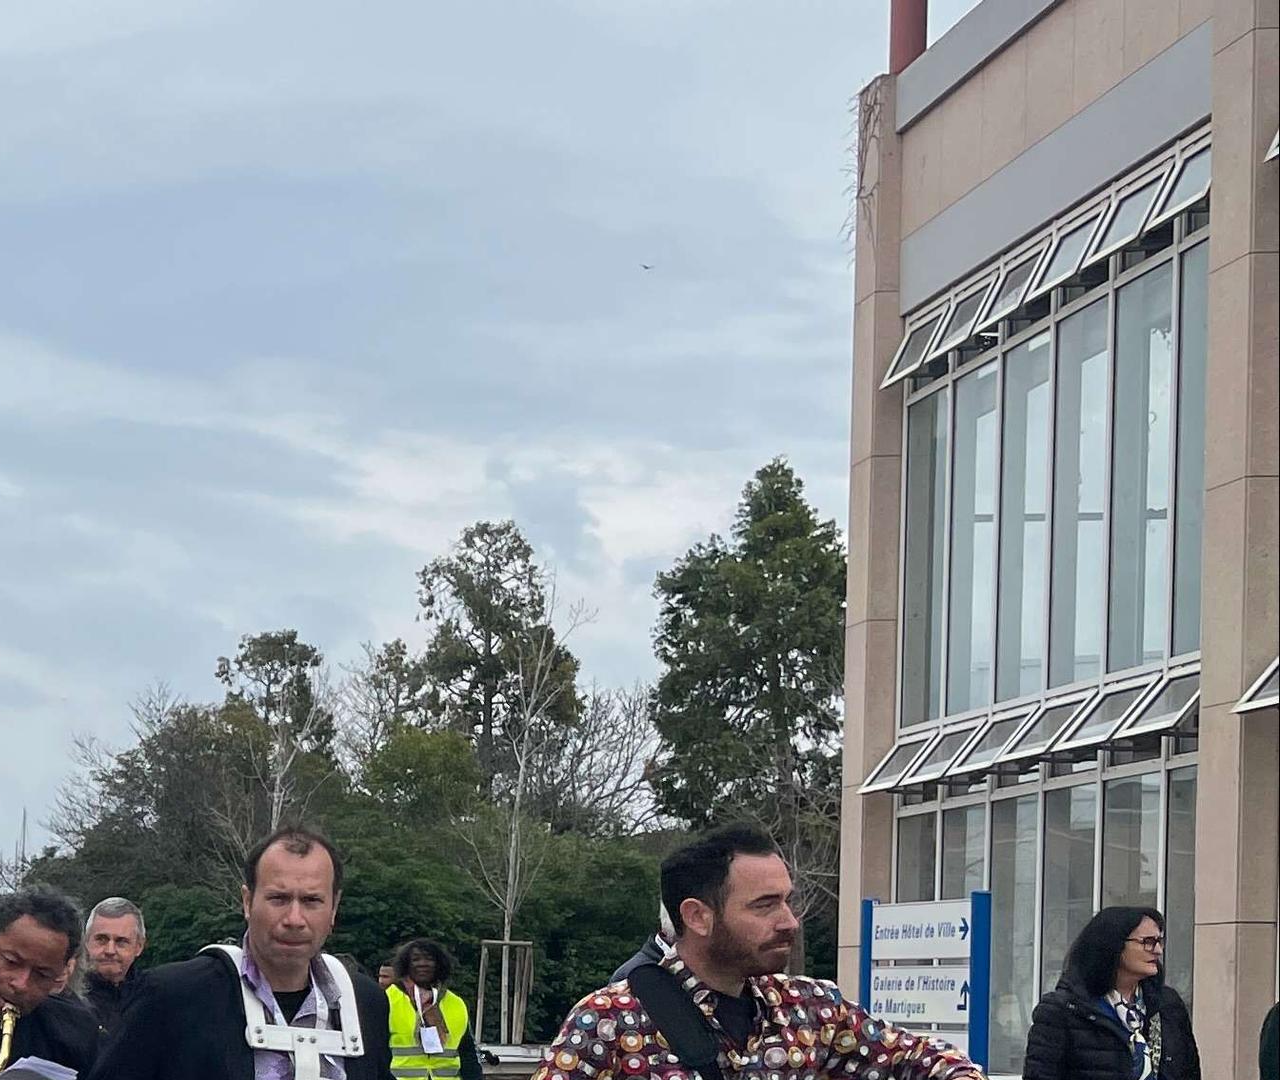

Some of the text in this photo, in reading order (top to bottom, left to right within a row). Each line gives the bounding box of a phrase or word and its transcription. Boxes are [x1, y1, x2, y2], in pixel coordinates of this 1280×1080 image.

[875, 922, 956, 940] Entrée Hôtel de Ville
[873, 976, 956, 991] Galerie de l'Histoire
[873, 998, 926, 1018] de Martigues
